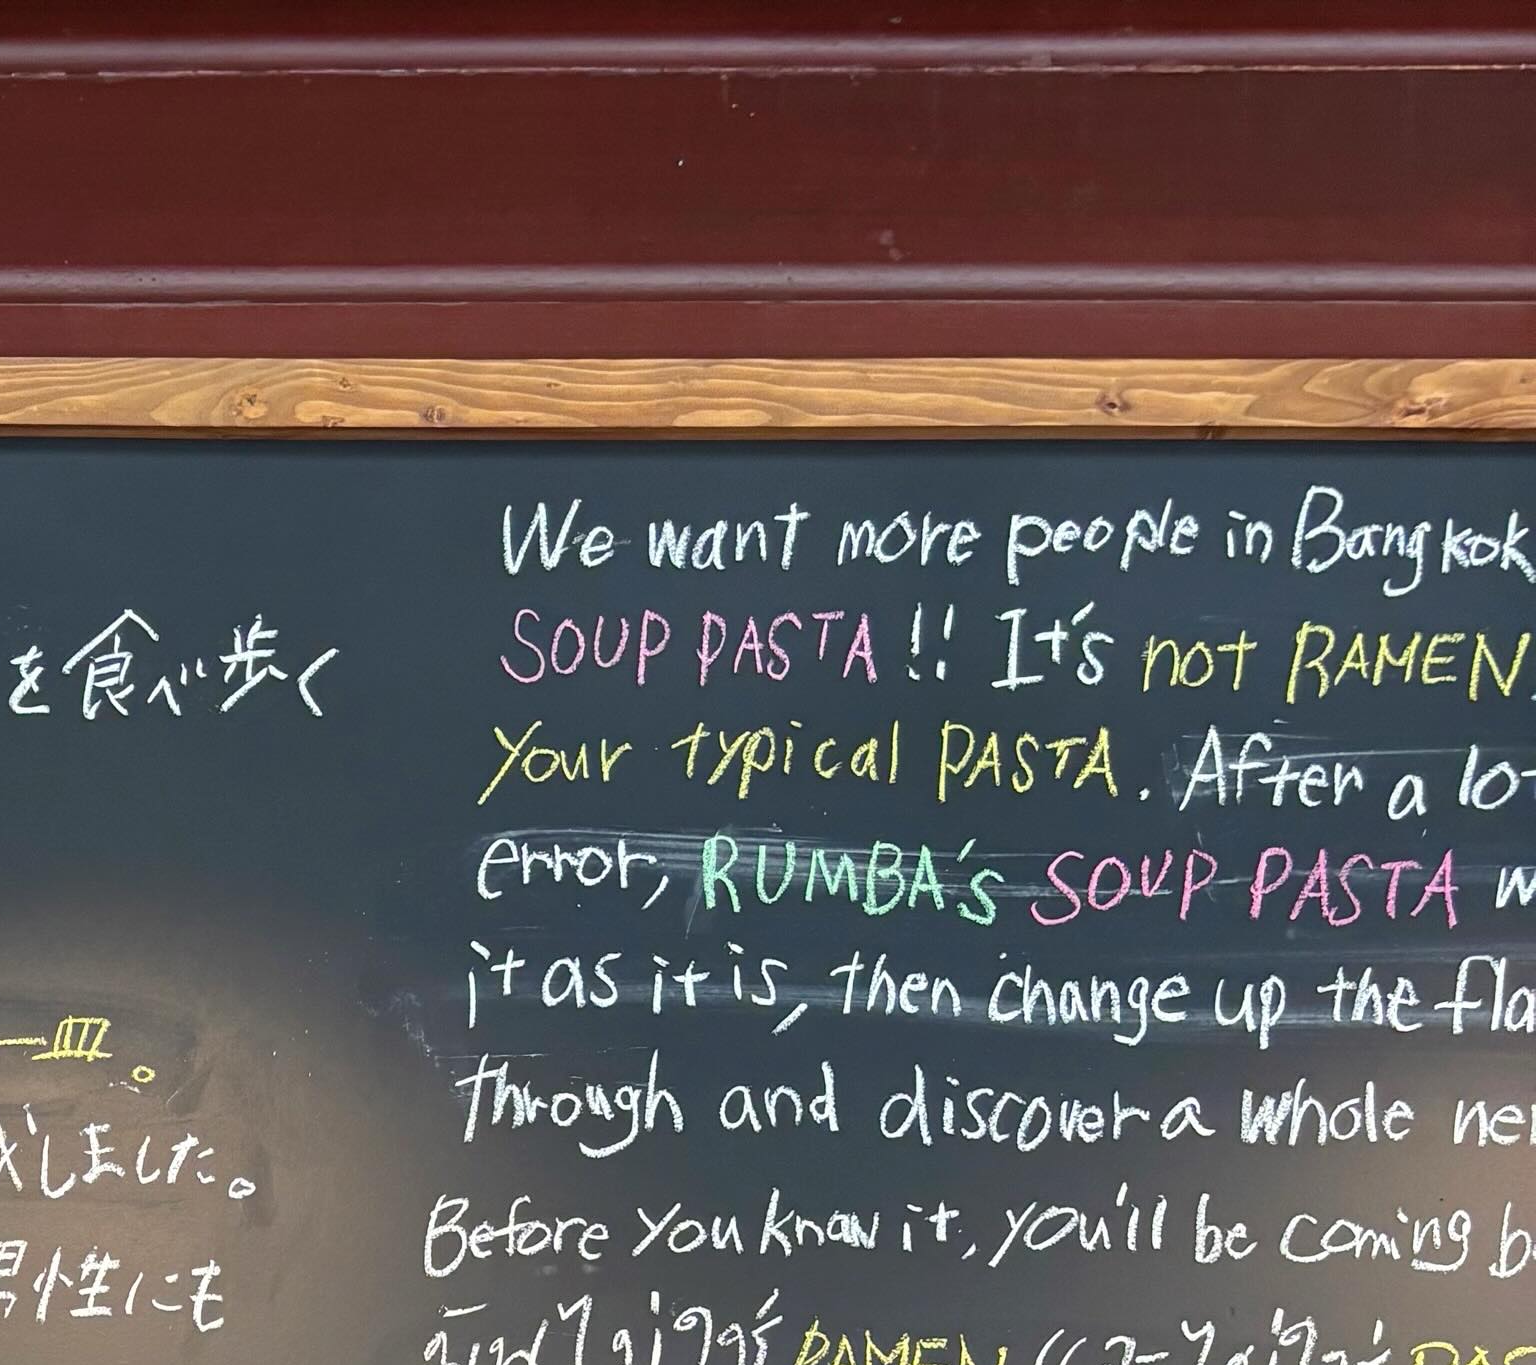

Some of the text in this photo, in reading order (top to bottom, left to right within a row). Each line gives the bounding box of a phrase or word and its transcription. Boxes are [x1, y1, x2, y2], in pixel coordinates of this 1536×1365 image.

[501, 485, 1536, 599] We want more people in Bangkok
[499, 606, 672, 688] SOUP
[696, 606, 877, 688] PASTA
[992, 602, 1118, 690] It's
[1141, 628, 1259, 699] not
[1286, 619, 1532, 705] RAMEN
[670, 713, 901, 802] typical
[1175, 723, 1365, 811] After
[1387, 773, 1427, 821] a
[1458, 744, 1536, 811] lo
[475, 834, 670, 912] error,
[701, 834, 1000, 927] RUMBA's
[1030, 847, 1219, 927] SOUP
[1248, 845, 1462, 929] PASTA
[468, 940, 525, 1029] it
[541, 950, 623, 1009] as
[652, 954, 712, 1015] it
[727, 941, 809, 1036] is,
[830, 949, 963, 1018] then
[987, 963, 1191, 1047] change
[1214, 975, 1287, 1050] up
[1317, 965, 1424, 1034] the
[455, 1049, 1536, 1159] through and discover a whole ne
[423, 1193, 611, 1279] Before
[986, 1181, 1168, 1268] you'll
[1194, 1193, 1259, 1265] be
[1279, 1204, 1472, 1273] coming
[1488, 1201, 1536, 1279] b
